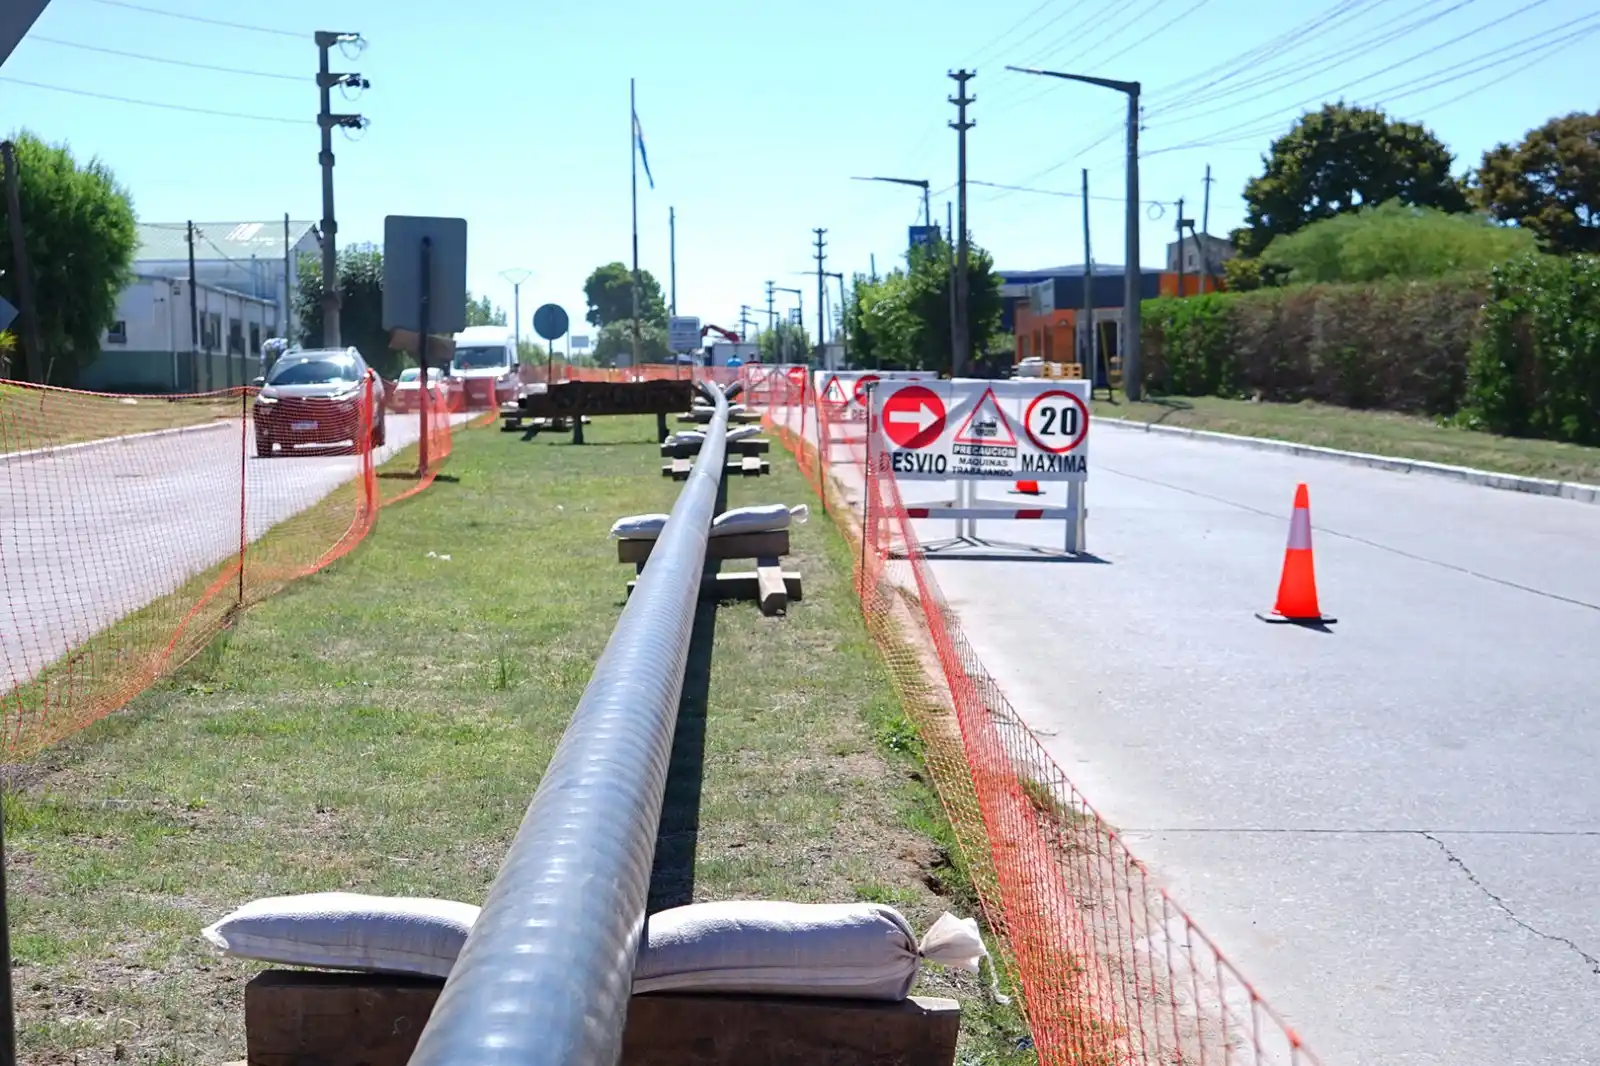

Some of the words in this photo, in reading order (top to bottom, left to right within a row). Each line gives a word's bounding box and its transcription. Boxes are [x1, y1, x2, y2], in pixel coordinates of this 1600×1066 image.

[1039, 406, 1078, 437] 20
[953, 443, 1016, 457] PRECAUCION
[958, 457, 1009, 467] MAQUINAS
[1021, 453, 1088, 474] MAXIMA
[952, 465, 1014, 478] TRABAJANDO
